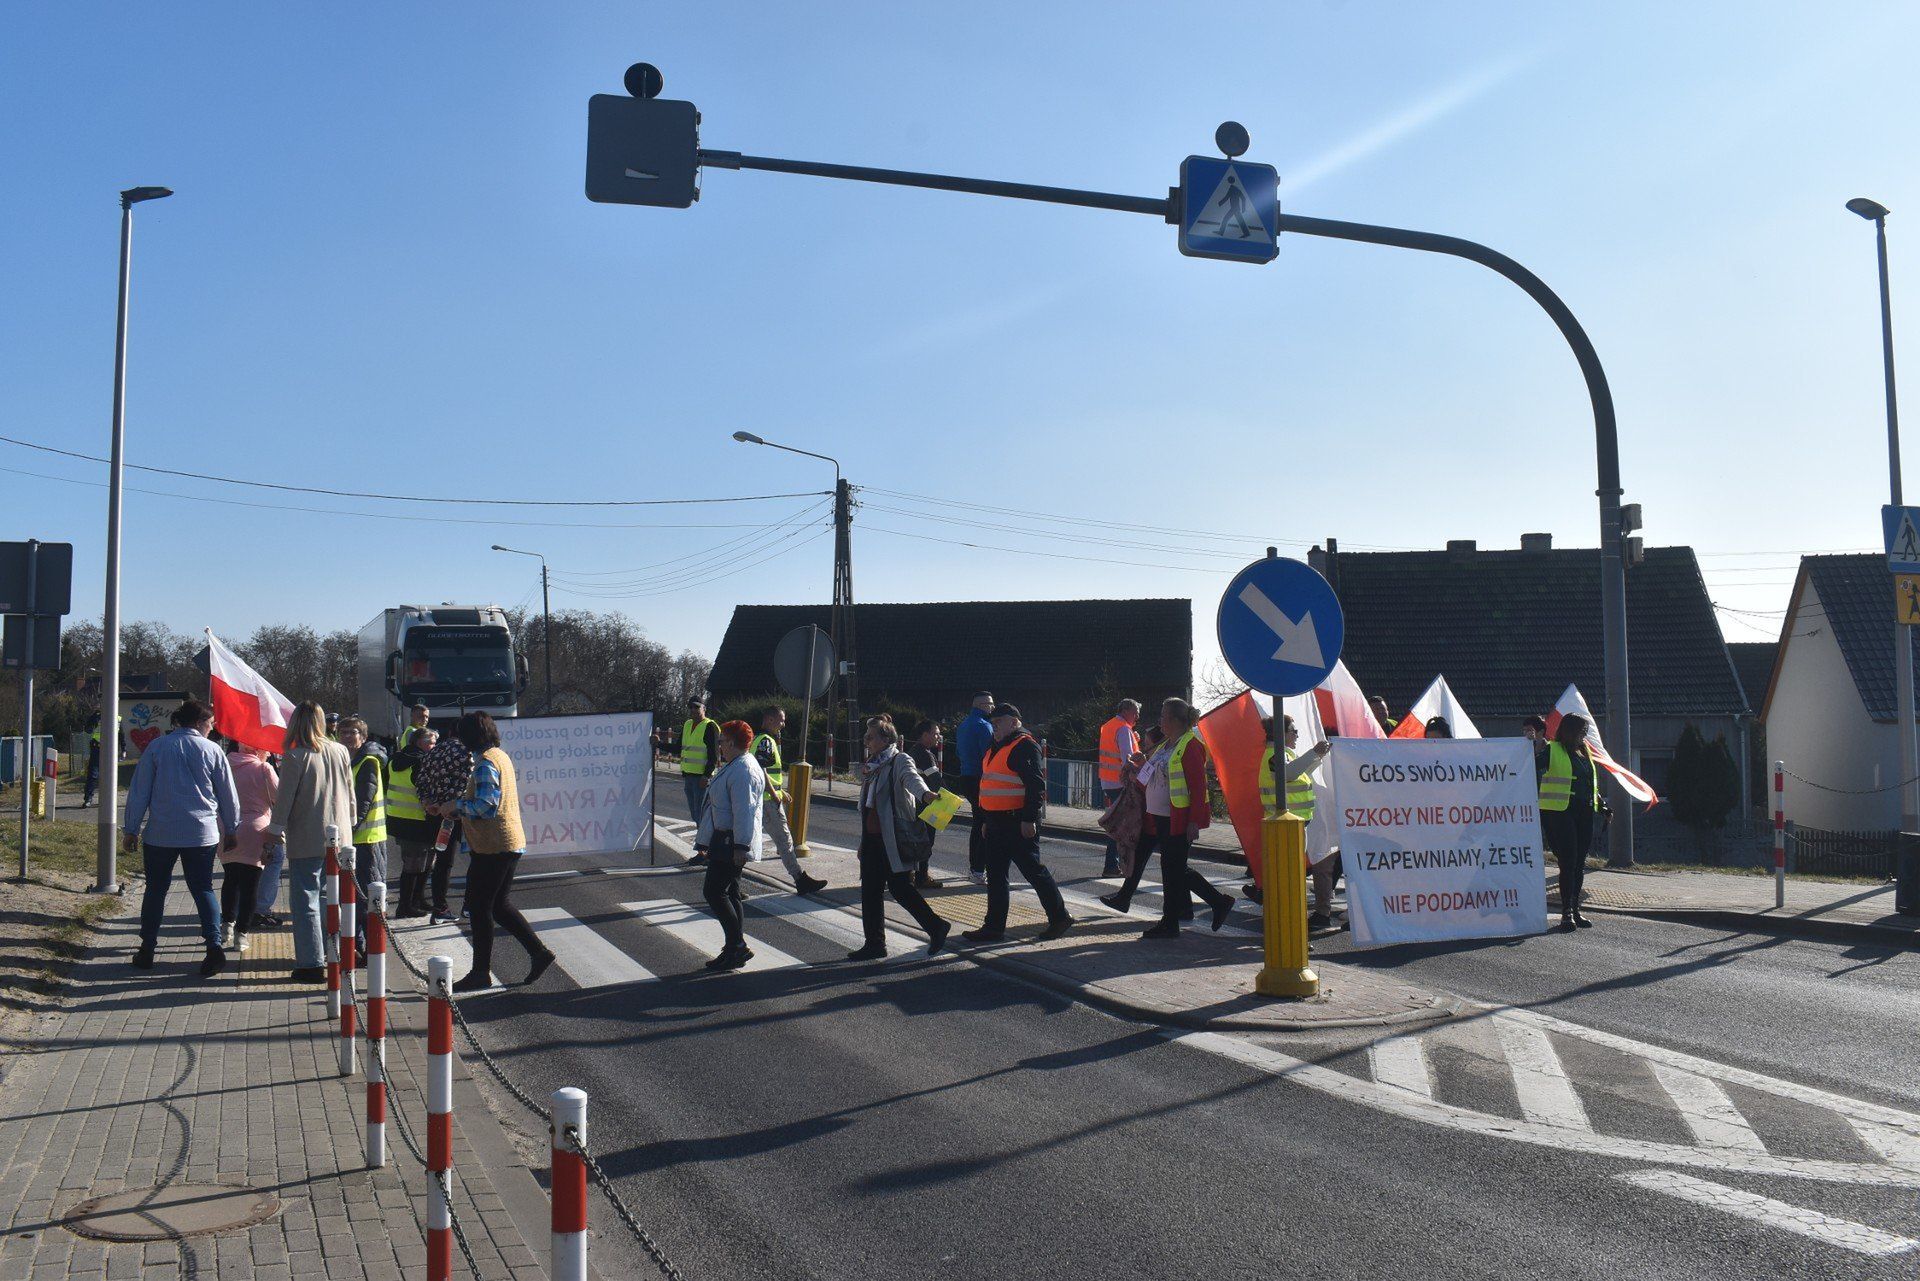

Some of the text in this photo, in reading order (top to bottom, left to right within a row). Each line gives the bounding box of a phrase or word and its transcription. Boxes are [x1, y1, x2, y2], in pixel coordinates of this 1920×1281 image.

[1359, 763, 1405, 783] GŁOS
[1408, 760, 1455, 783] SWÓJ
[1345, 807, 1412, 828] SZKOŁY
[1417, 806, 1445, 826] NIE
[1449, 805, 1515, 825] ODDAMY
[1356, 843, 1533, 871] I ZAPEWNIAMY, ŻE SIĘ
[1383, 894, 1412, 914] NIE
[1416, 889, 1501, 913] PODDAMY
